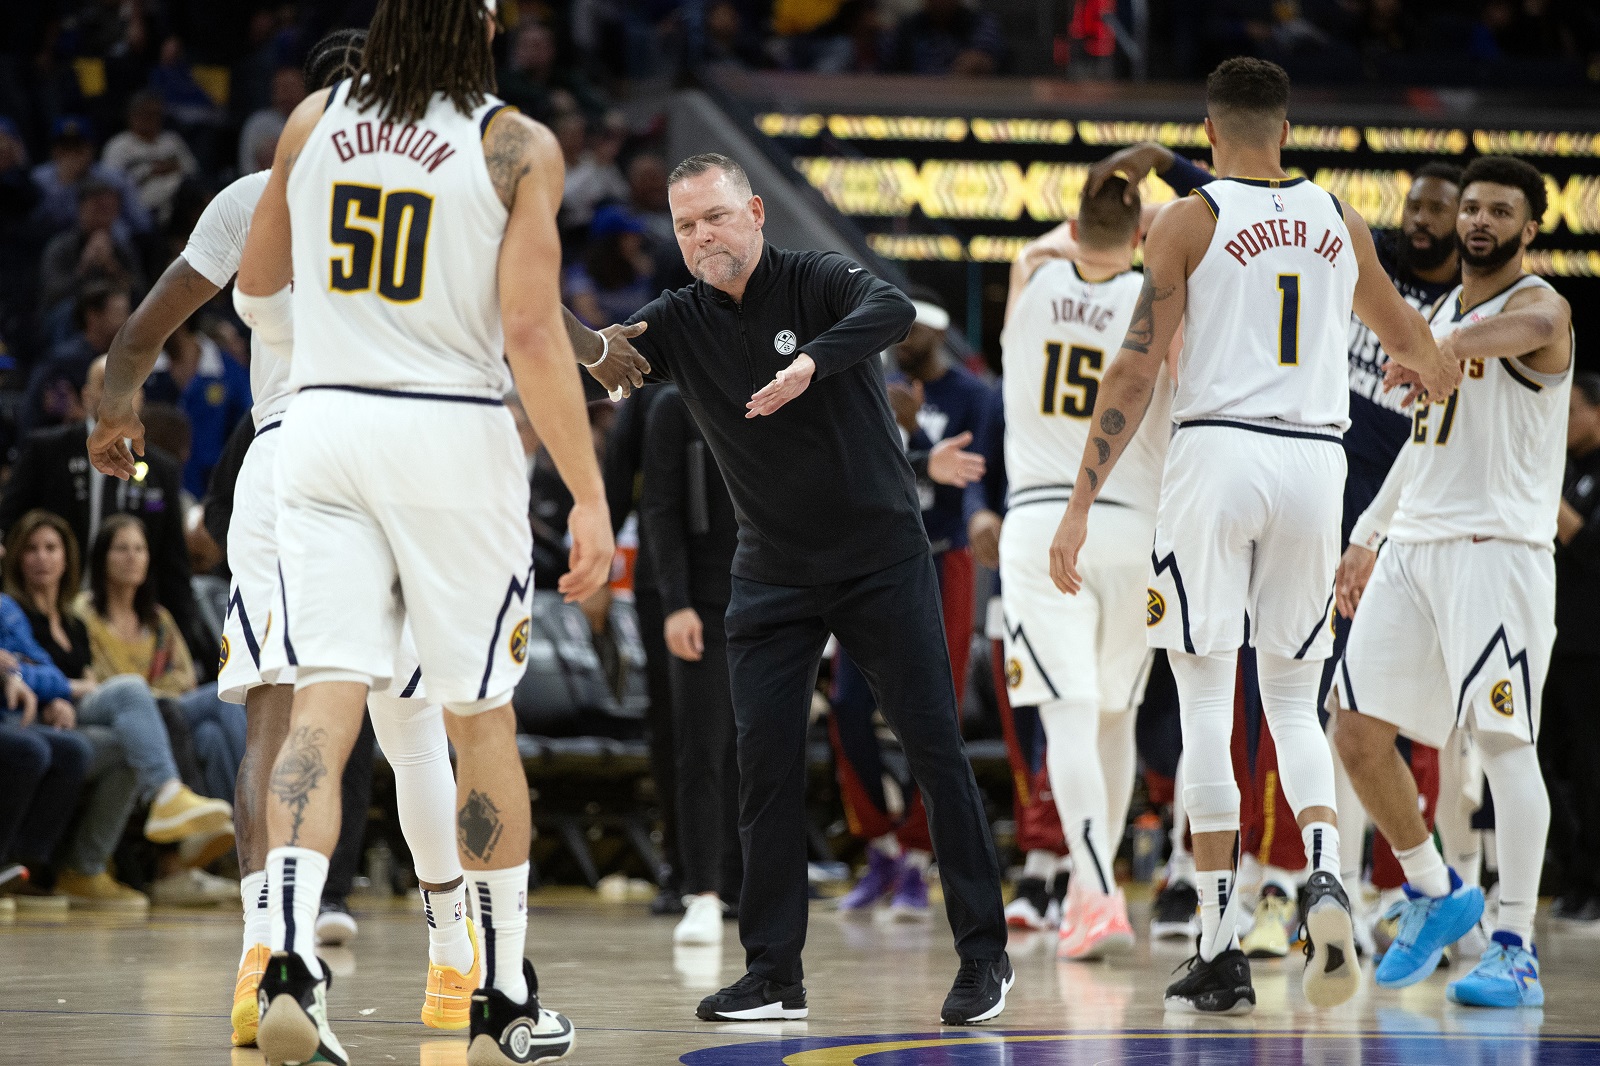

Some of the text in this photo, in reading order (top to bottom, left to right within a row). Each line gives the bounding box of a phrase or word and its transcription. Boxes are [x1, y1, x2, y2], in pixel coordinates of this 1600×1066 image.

[331, 121, 455, 174] GORDON
[328, 181, 435, 305] 50
[1224, 219, 1343, 268] PORTER JR.
[1276, 273, 1301, 367] 1
[1041, 341, 1104, 420] 15
[1412, 386, 1460, 447] 27
